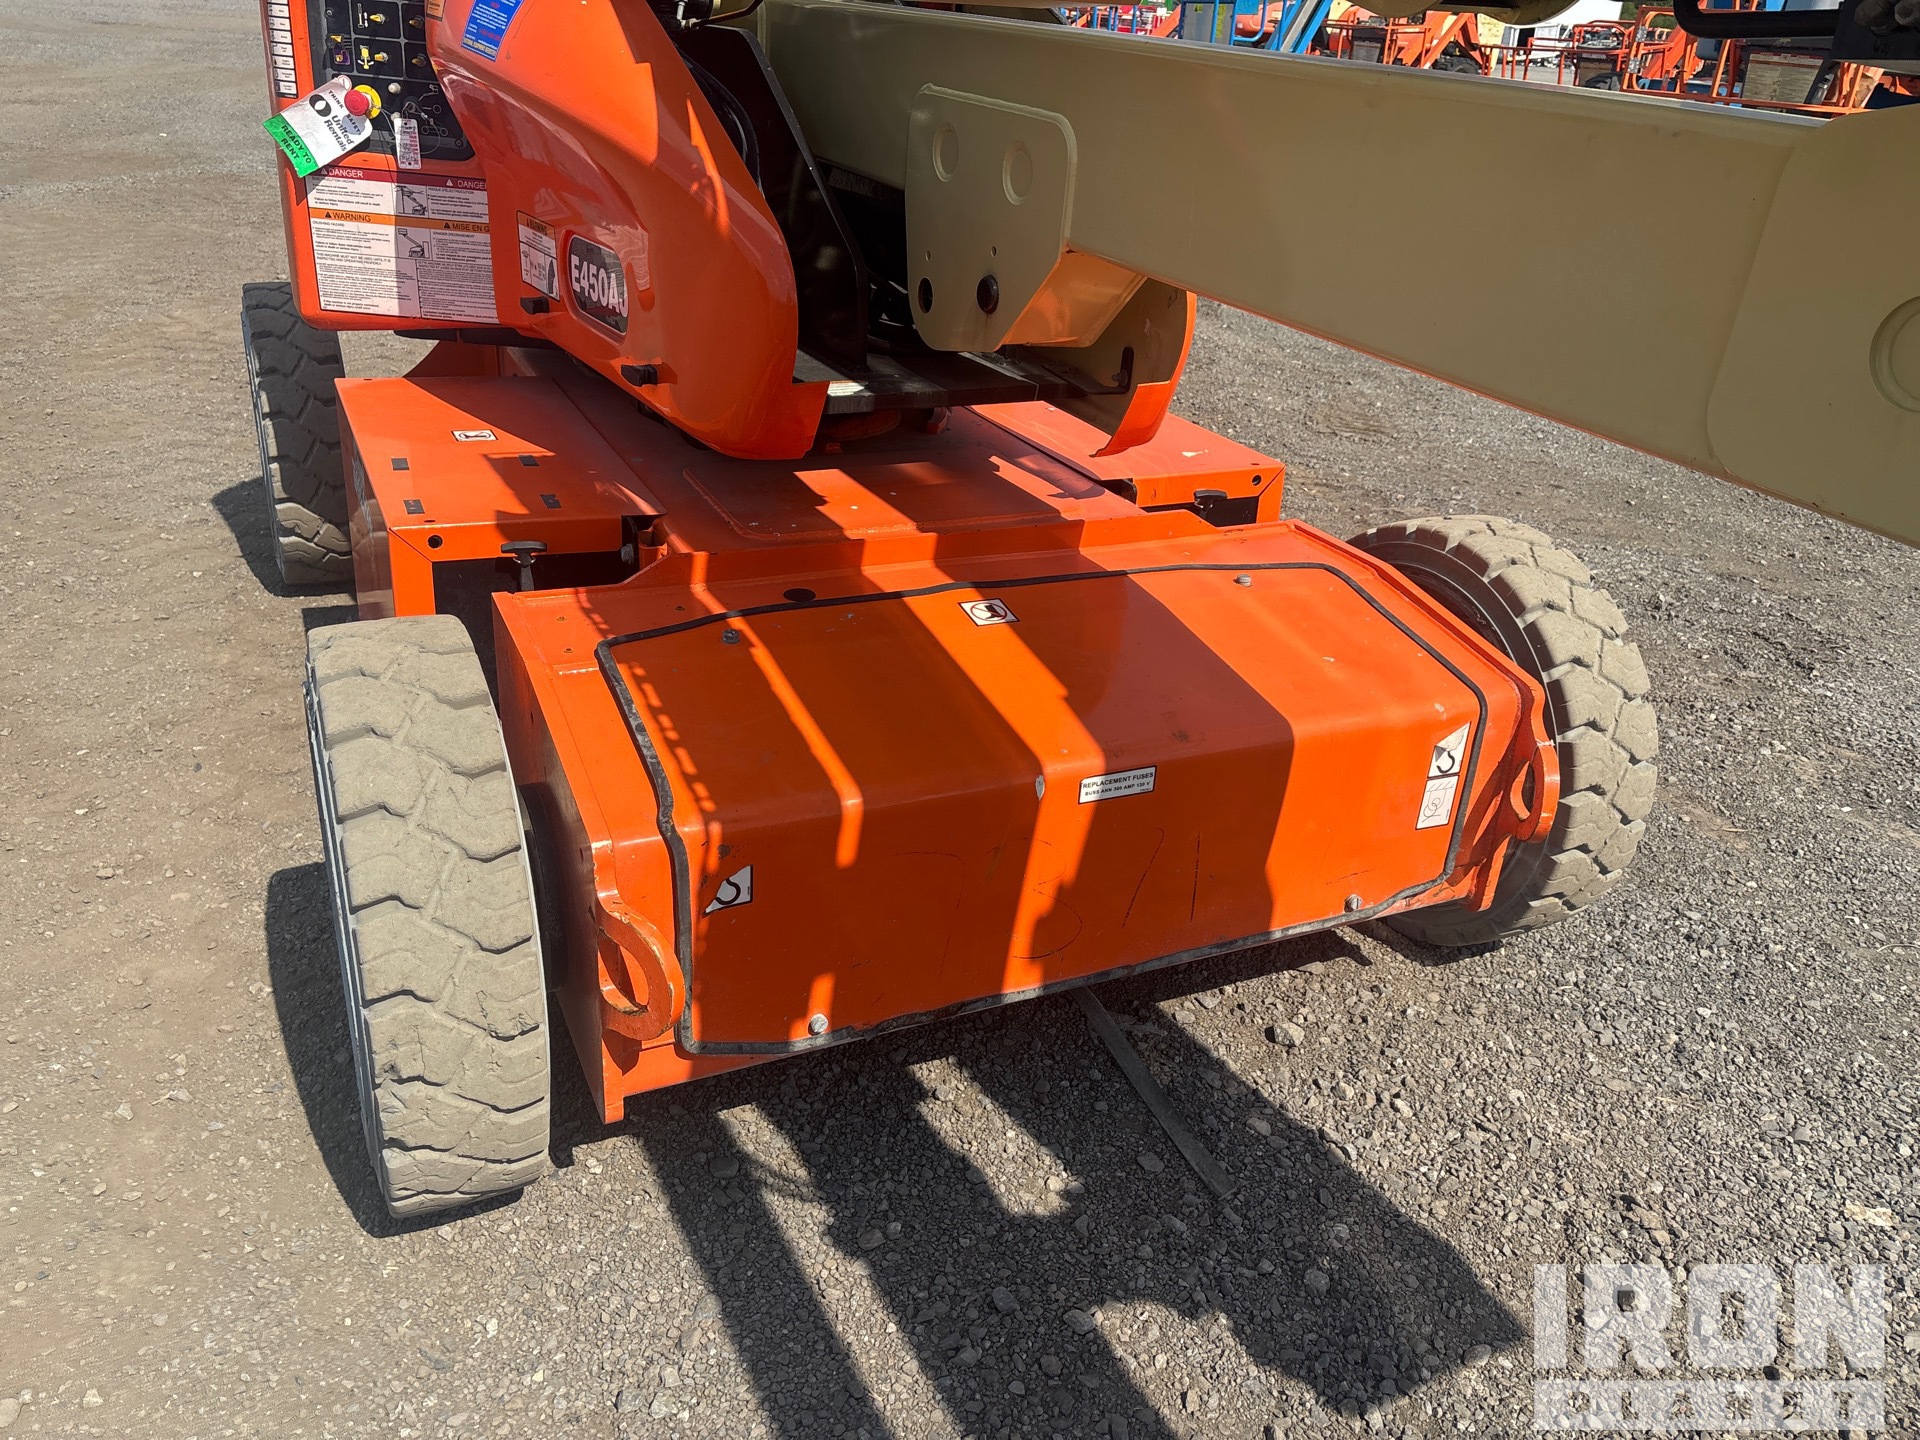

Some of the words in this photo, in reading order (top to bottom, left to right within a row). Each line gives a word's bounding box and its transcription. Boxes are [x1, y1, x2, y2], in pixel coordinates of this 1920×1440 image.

[328, 90, 344, 109] THINK
[324, 119, 348, 152] Rentals
[331, 114, 354, 145] United
[346, 114, 361, 136] SAFETY
[281, 124, 304, 150] READY
[303, 151, 312, 164] TO
[281, 138, 300, 160] RENT
[328, 168, 364, 178] DANGER
[332, 212, 371, 222] WARNING
[452, 223, 470, 231] MISE
[471, 224, 482, 232] EN
[570, 253, 629, 318] E450AJ
[1082, 775, 1132, 789] REPLACEMENT
[1132, 772, 1154, 781] FUSES
